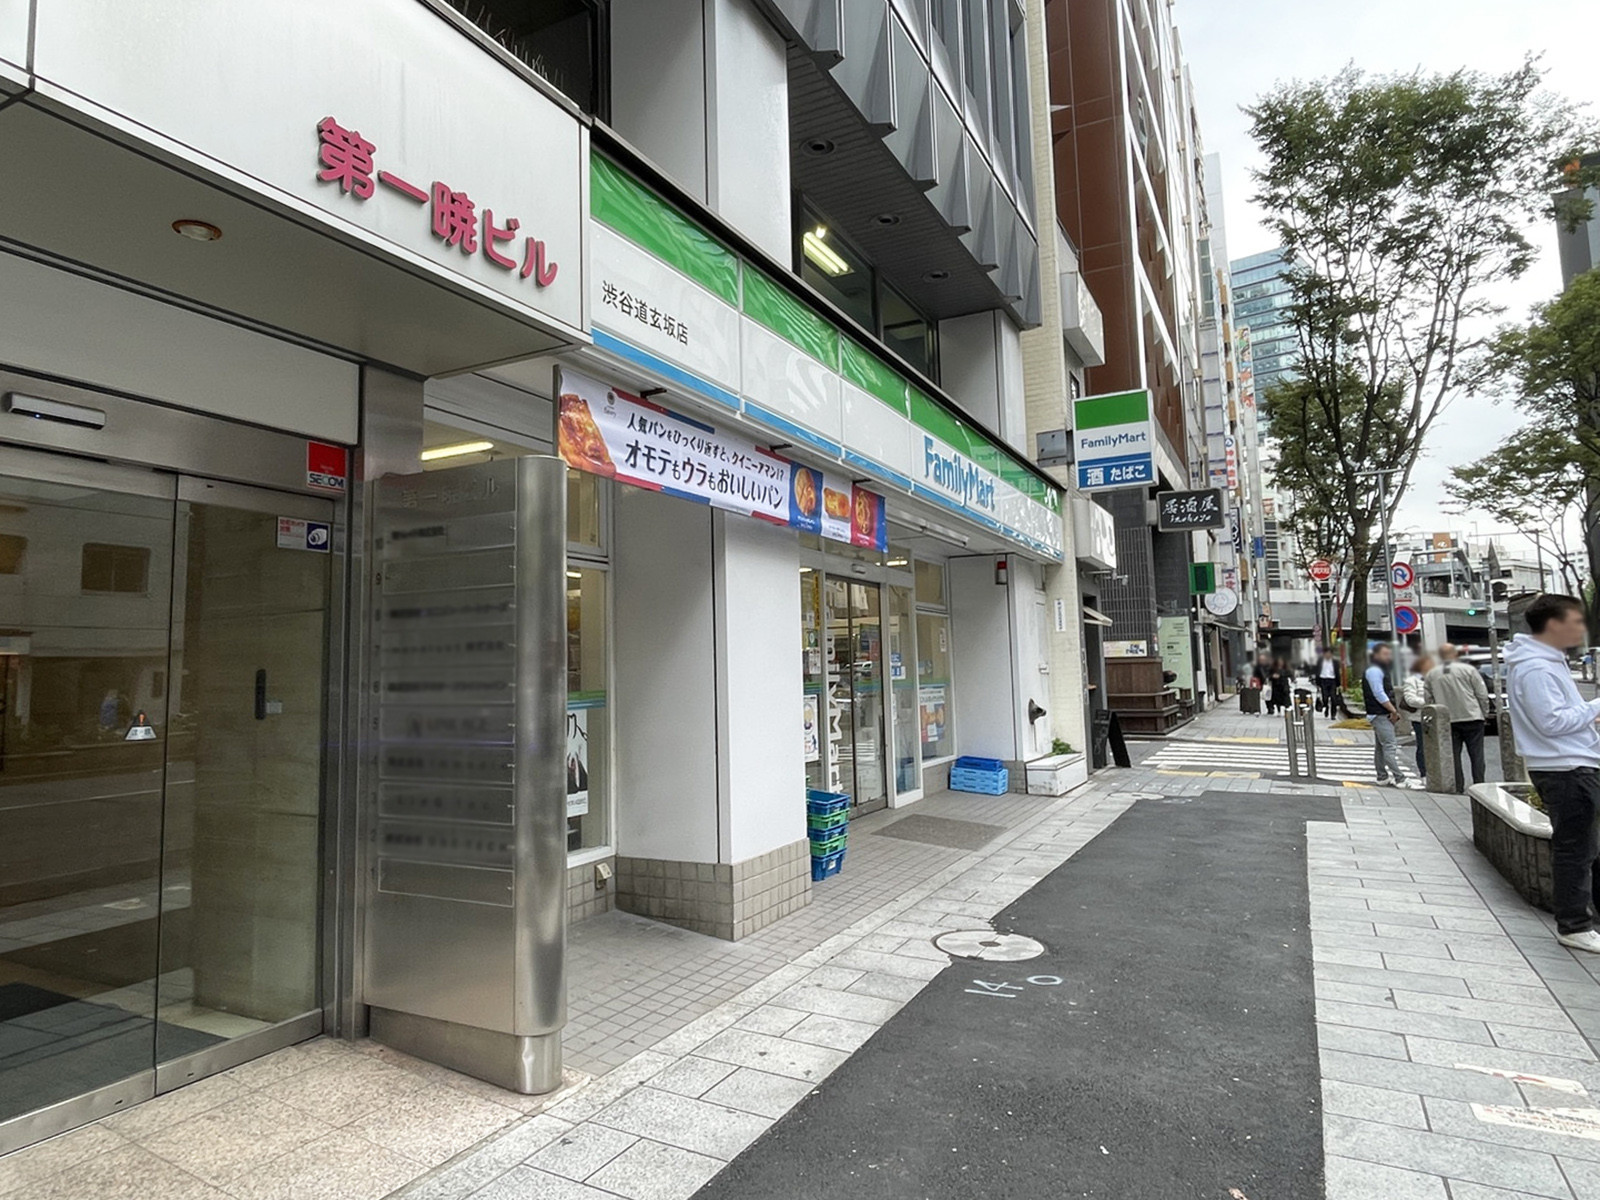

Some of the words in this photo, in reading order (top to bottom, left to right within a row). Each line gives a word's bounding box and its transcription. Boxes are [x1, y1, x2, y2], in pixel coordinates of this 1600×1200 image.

[317, 116, 557, 287] 第一暁ビル
[602, 281, 688, 345] 渋谷道玄坂店
[1081, 432, 1146, 449] FamilyMart
[309, 473, 344, 488] SECOM
[625, 440, 783, 509] オモテもウラもおいしいパン
[924, 435, 995, 512] FamilyMart
[1087, 467, 1103, 485] 酒
[1110, 465, 1146, 481] たばこ
[1162, 495, 1218, 515] 居酒屋
